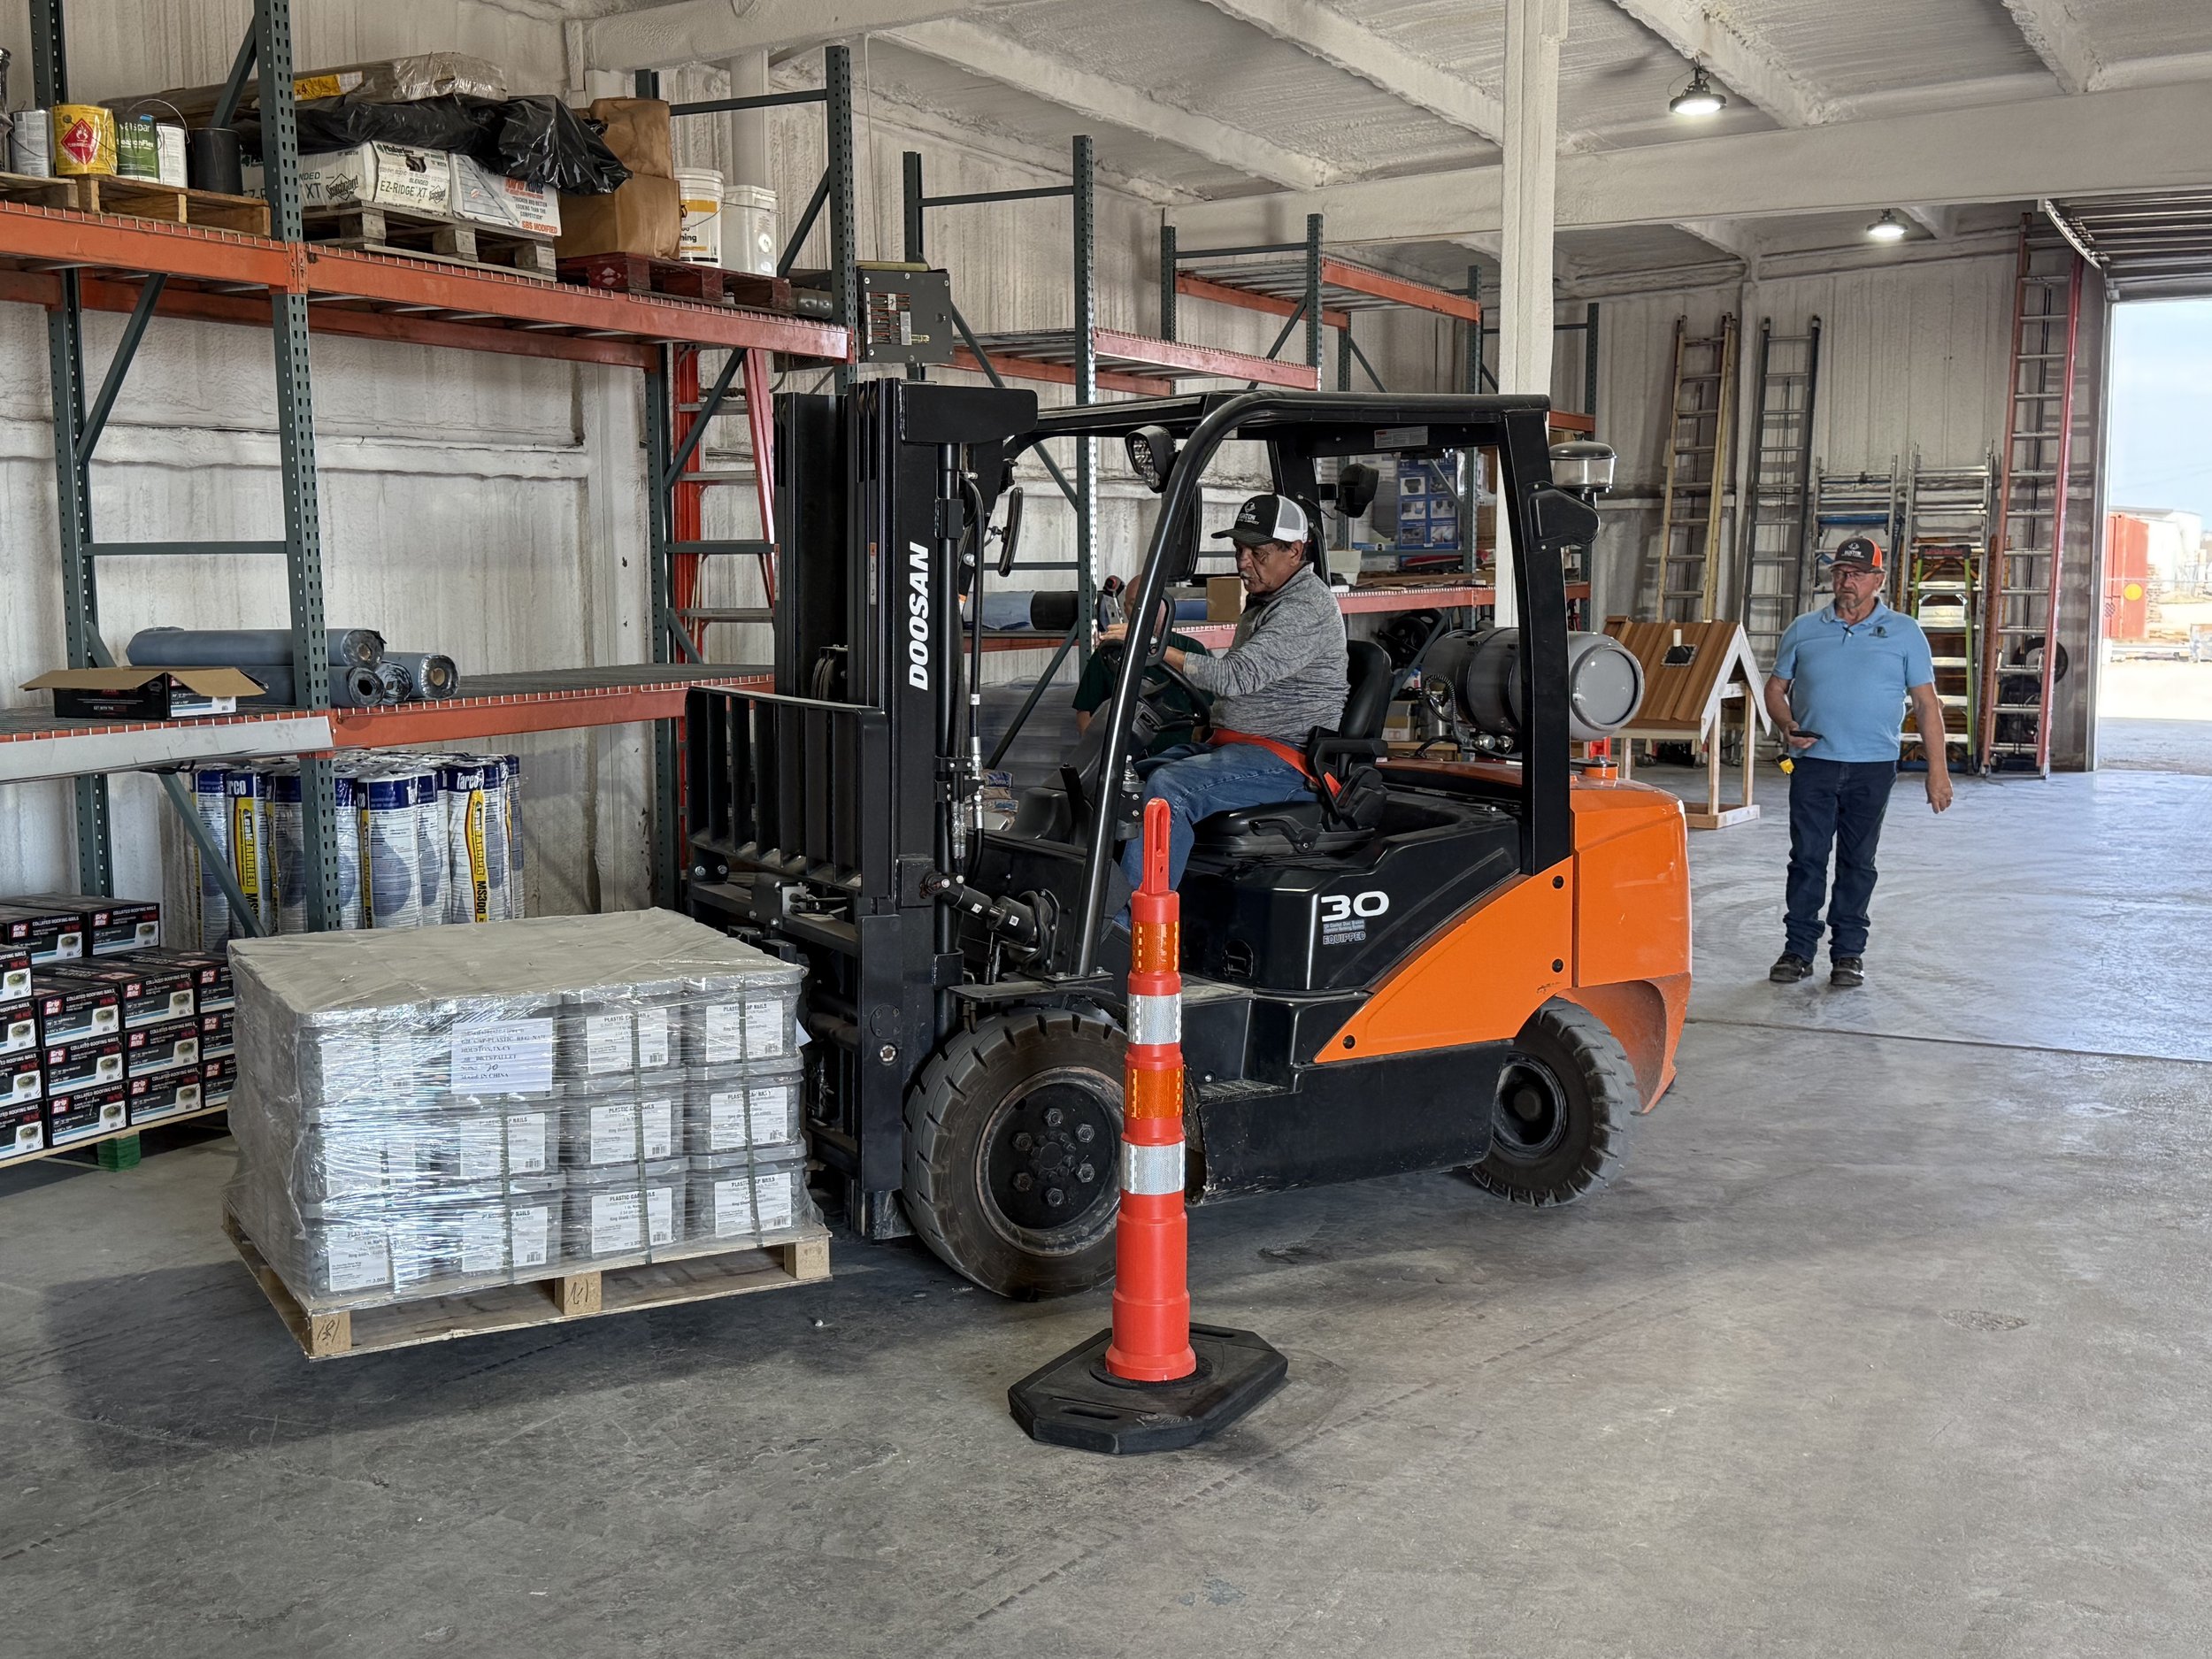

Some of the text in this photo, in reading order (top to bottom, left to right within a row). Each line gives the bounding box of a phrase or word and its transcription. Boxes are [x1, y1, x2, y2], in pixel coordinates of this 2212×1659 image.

[380, 180, 428, 198] EZ-RIDGE XT
[909, 541, 929, 691] DOOSAN
[476, 880, 488, 914] MS300
[1321, 891, 1389, 922] 30
[1323, 931, 1366, 945] EQUIPPED
